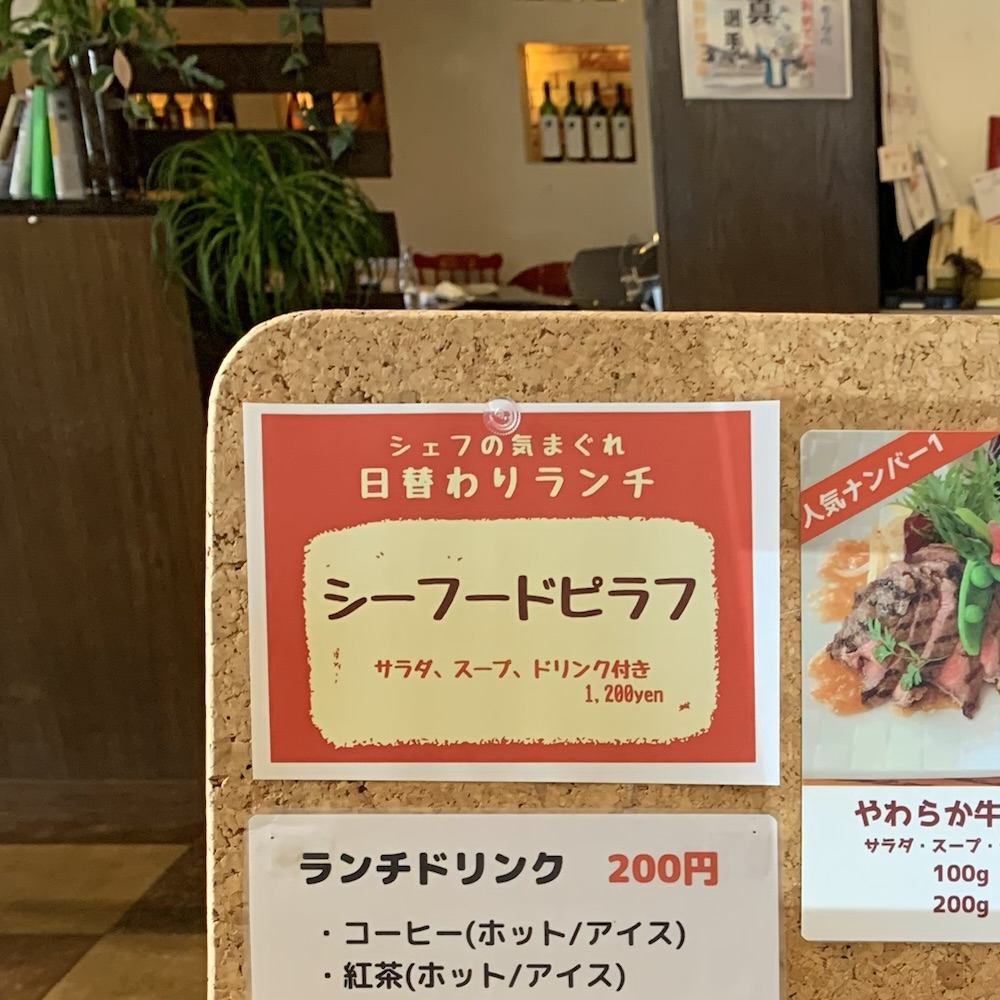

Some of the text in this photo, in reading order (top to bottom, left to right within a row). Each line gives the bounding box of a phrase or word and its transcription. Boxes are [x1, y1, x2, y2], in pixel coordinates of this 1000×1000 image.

[389, 433, 625, 457] シェフの気まぐれ
[361, 467, 654, 498] 日替わりランチ
[803, 433, 944, 529] 人気ナンバー1
[324, 575, 696, 621] シーフードピラフ
[586, 684, 663, 704] 1,200yen
[300, 852, 718, 886] ランチドリンク 200円
[934, 865, 988, 887] 100g
[933, 896, 988, 918] 200g
